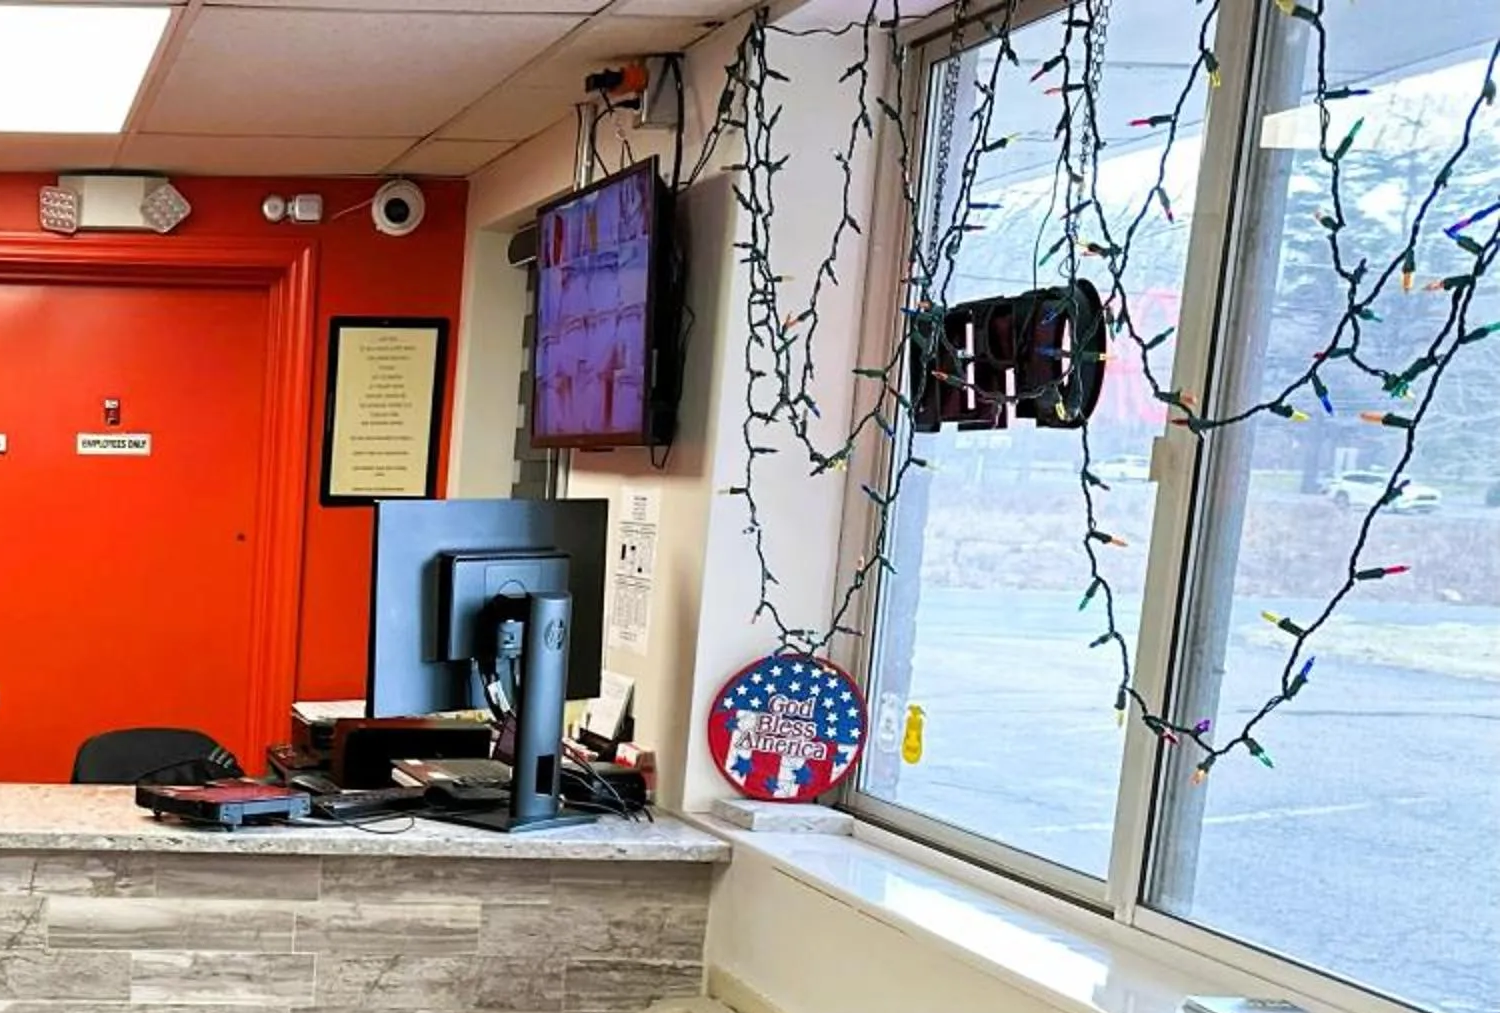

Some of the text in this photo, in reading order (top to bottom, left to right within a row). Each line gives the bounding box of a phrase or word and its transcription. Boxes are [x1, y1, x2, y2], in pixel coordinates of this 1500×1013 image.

[81, 439, 146, 448] EMPLOYEES ONLY
[768, 695, 816, 717] God
[758, 715, 817, 739] Bless
[738, 731, 826, 759] America
